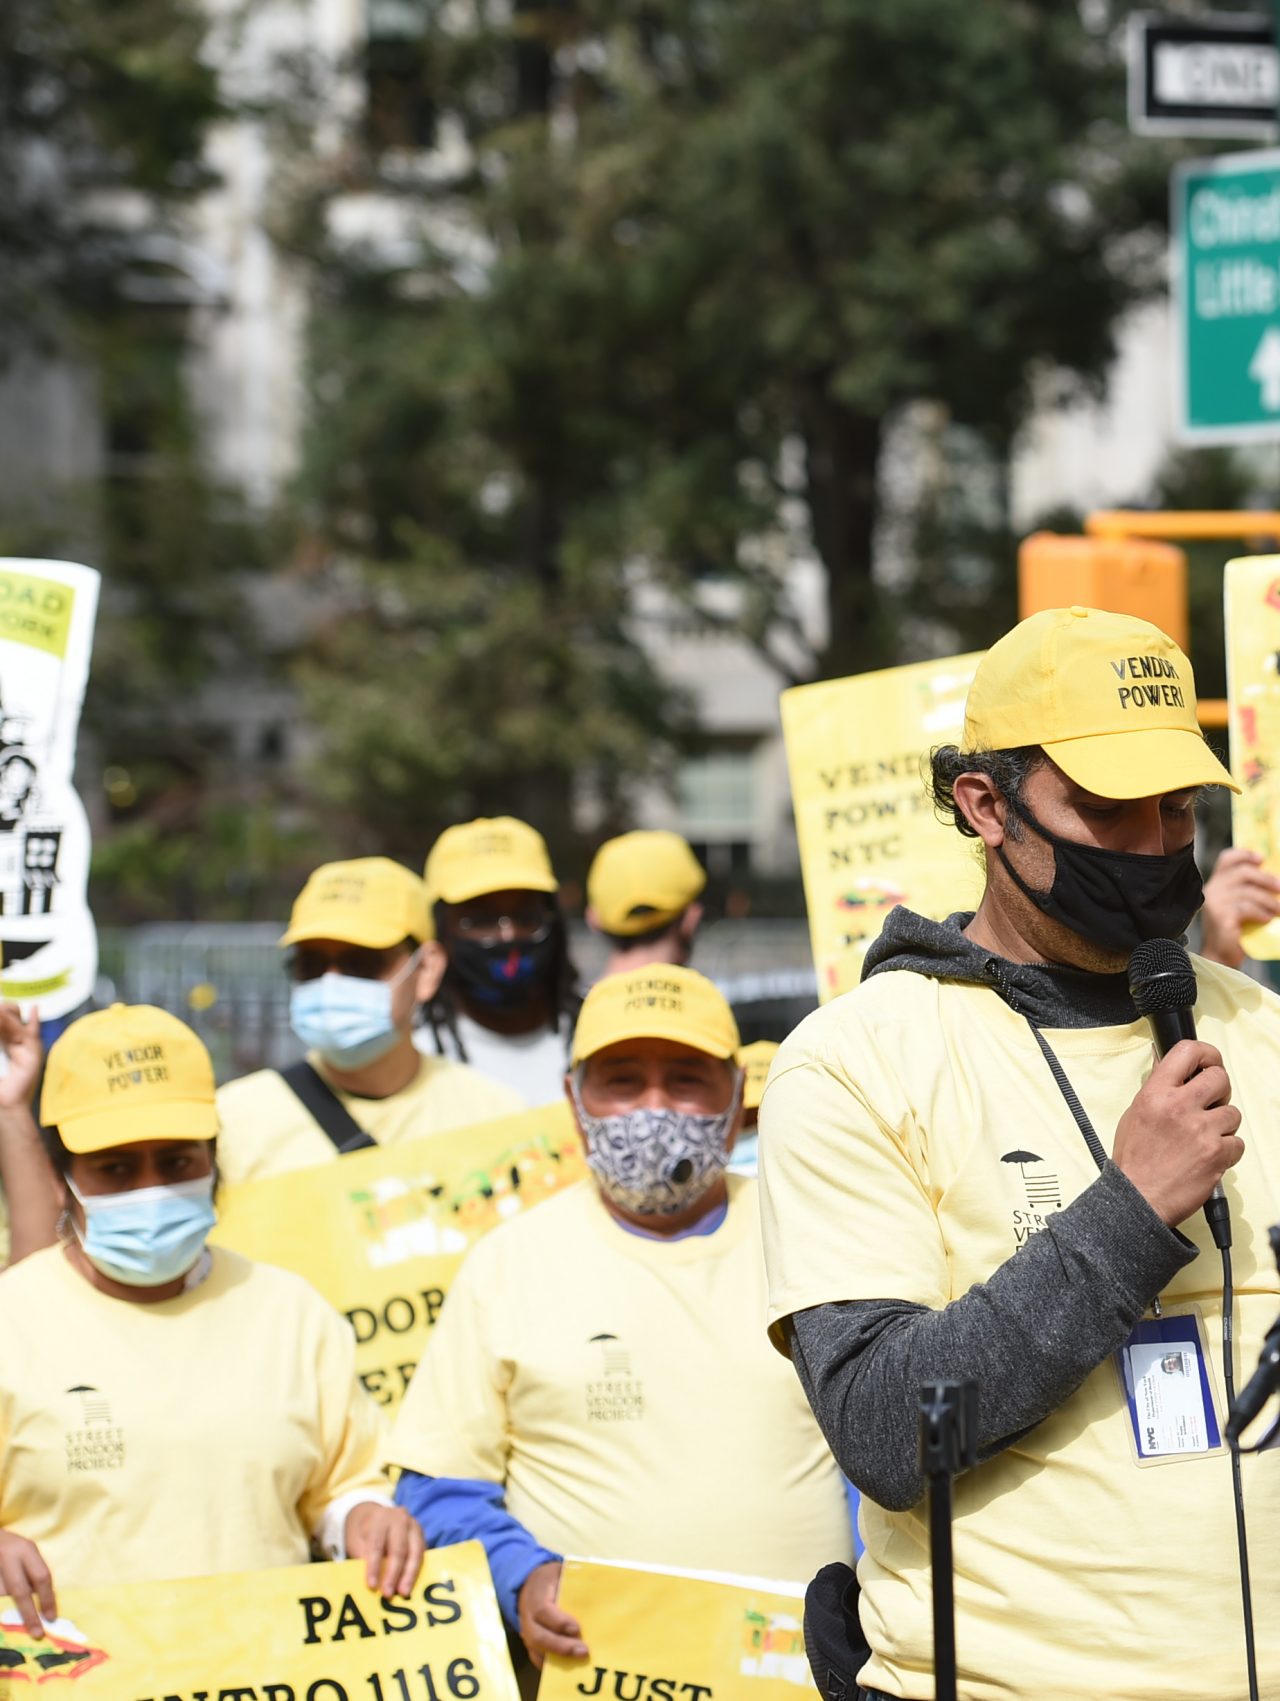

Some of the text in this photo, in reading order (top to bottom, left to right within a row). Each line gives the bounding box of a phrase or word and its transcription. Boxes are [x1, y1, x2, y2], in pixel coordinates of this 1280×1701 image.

[1195, 256, 1278, 319] Little
[1110, 655, 1180, 680] VENDOR
[1118, 685, 1185, 709] POWER!
[820, 753, 928, 790] VEND
[1013, 1210, 1047, 1227] STR
[345, 1288, 445, 1344] DOR
[1146, 1427, 1157, 1450] NYC
[298, 1579, 463, 1645] PASS
[366, 1658, 481, 1701] 1116
